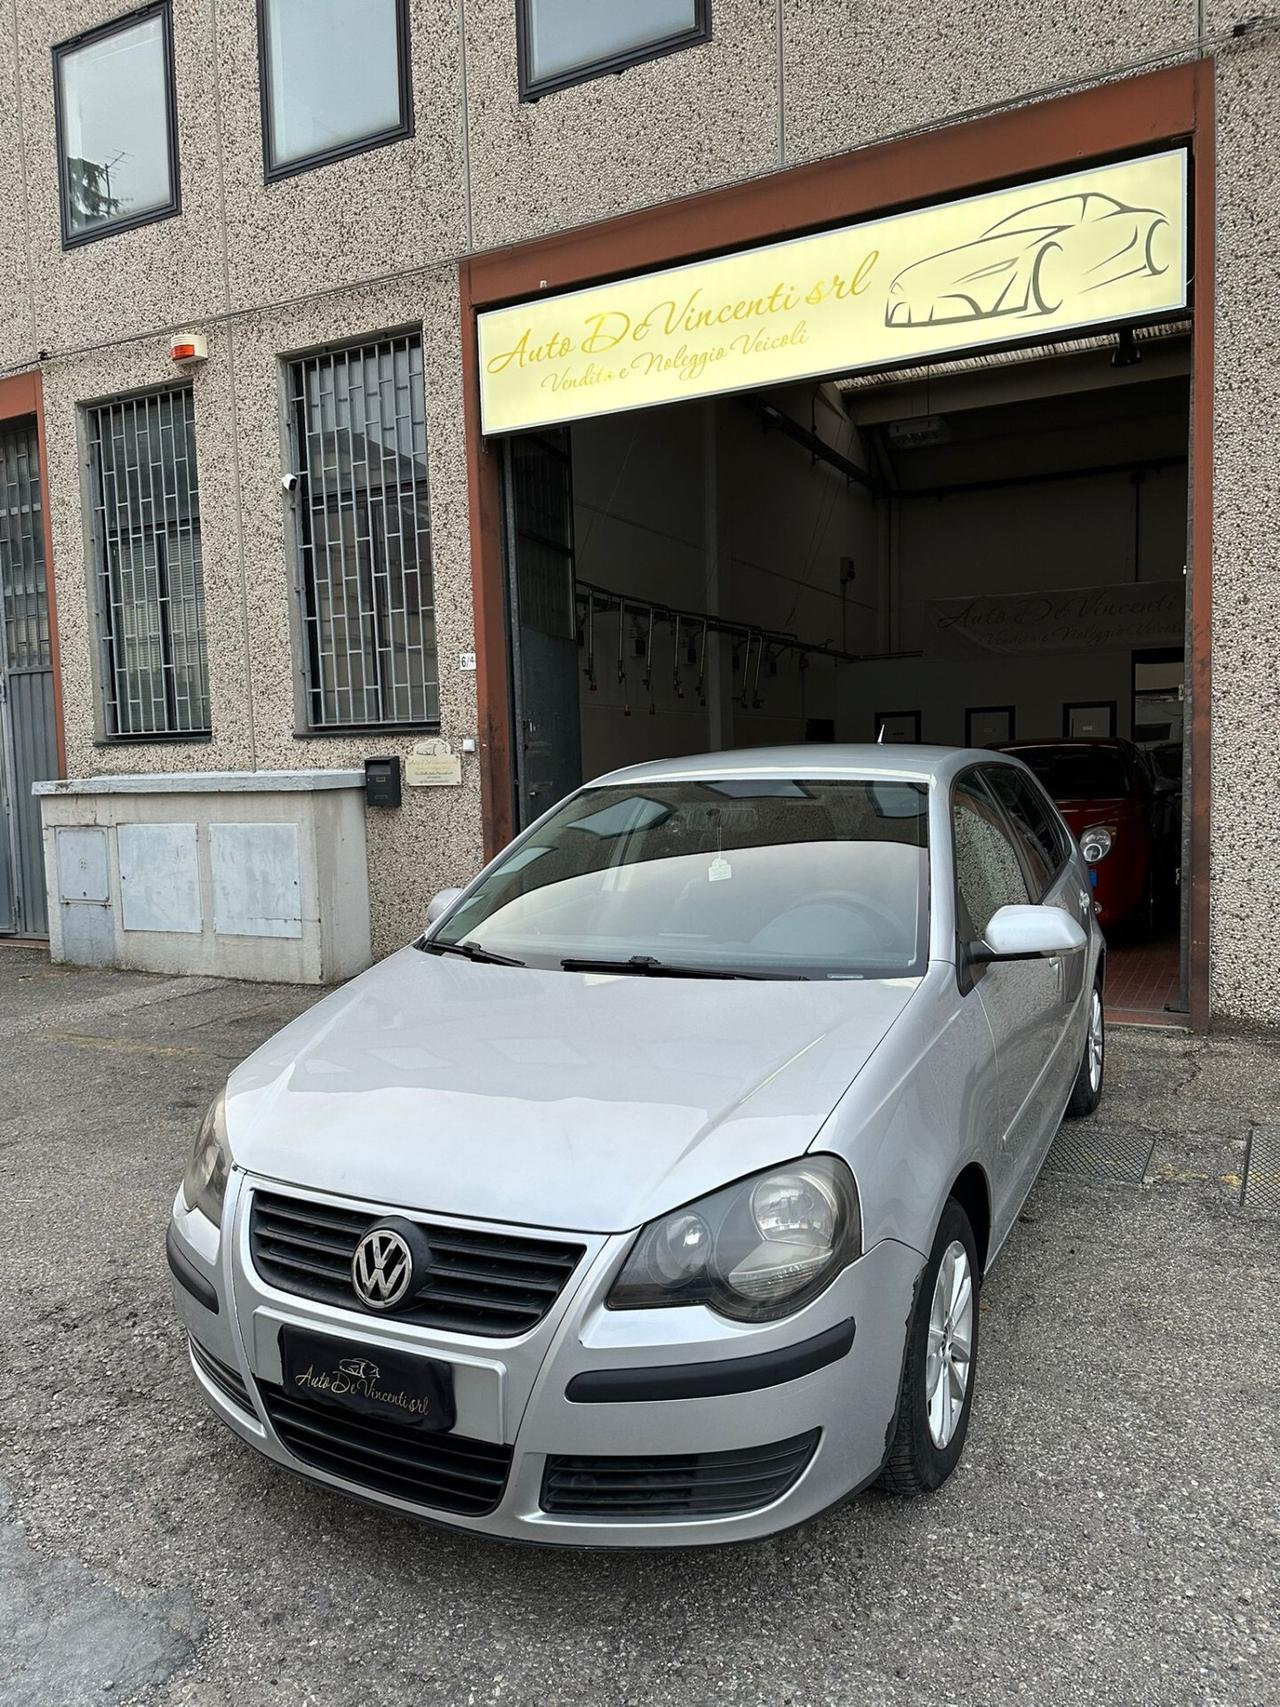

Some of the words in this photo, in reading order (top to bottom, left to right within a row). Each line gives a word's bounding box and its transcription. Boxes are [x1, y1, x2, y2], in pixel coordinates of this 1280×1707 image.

[487, 328, 576, 374] Auto
[581, 311, 651, 353] De
[646, 282, 800, 335] Vincenti
[805, 250, 880, 305] srl
[618, 367, 630, 380] e
[631, 344, 728, 382] Noleggio
[729, 319, 808, 355] Veicoli
[295, 1364, 331, 1387] Auto
[331, 1370, 356, 1394] De
[356, 1378, 408, 1408] Vincenti
[408, 1396, 429, 1416] srl
